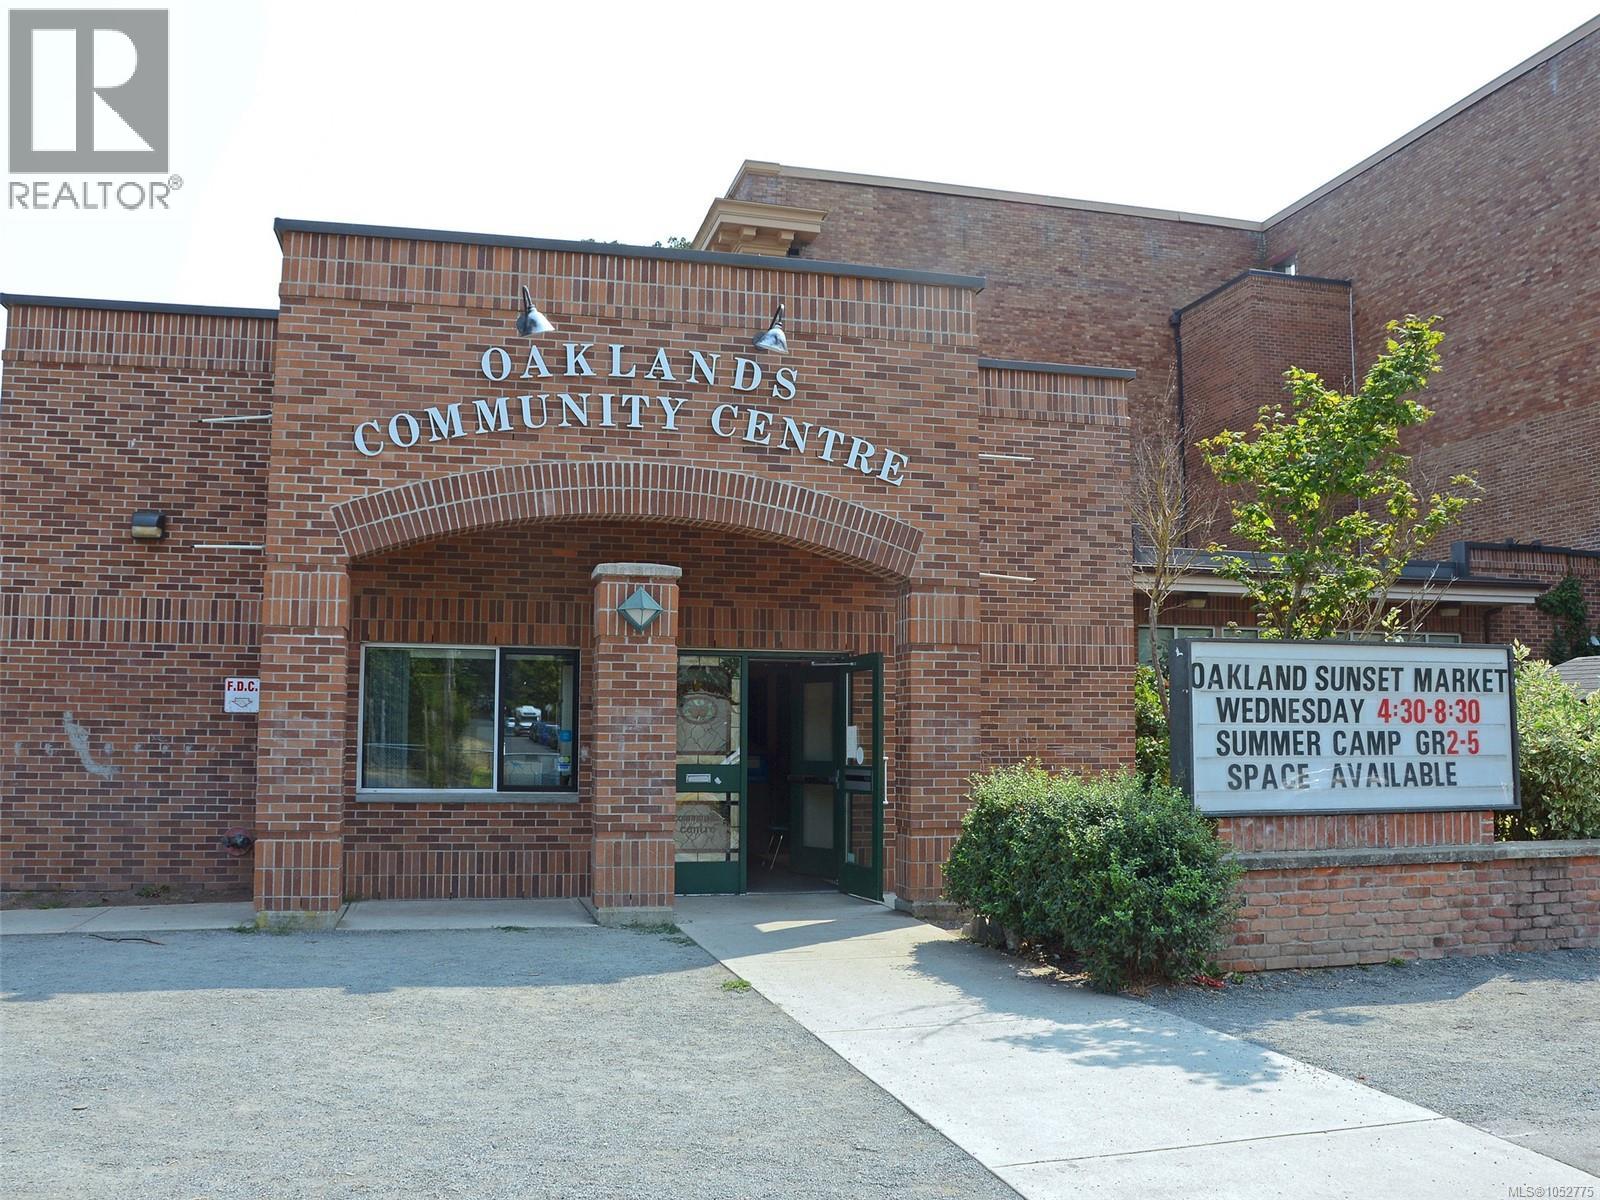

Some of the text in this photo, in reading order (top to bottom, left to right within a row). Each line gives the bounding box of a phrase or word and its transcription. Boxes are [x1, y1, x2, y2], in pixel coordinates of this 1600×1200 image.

[480, 342, 798, 401] OAKLANDS
[353, 392, 909, 487] COMMUNITY CENTRE
[227, 681, 258, 692] F.D.C.
[1191, 663, 1508, 692] OAKLAND SUNSET MARKET
[1216, 697, 1481, 724] WEDNESDAY 4:30-8:30
[1216, 730, 1321, 757] SUMMER
[1333, 730, 1402, 756] CAMP
[1227, 762, 1458, 790] SPACE AVAILABLE
